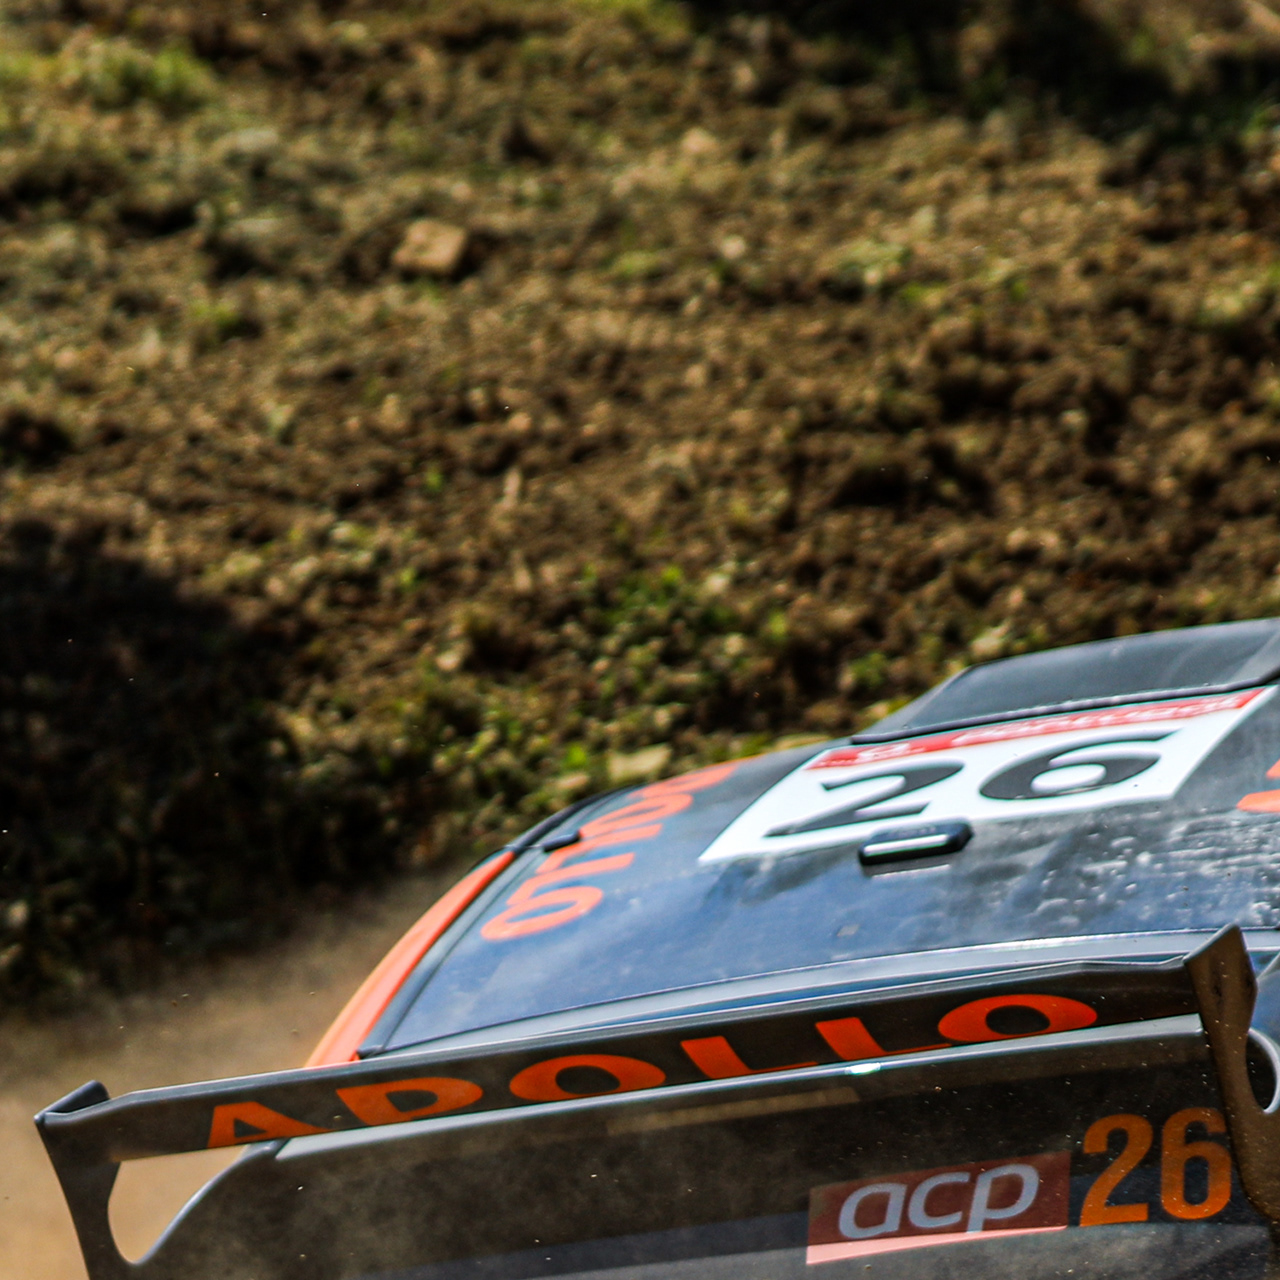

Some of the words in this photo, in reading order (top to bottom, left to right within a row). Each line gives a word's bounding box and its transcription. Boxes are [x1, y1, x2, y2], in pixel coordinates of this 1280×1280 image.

[762, 729, 1184, 838] 26
[207, 993, 1098, 1149] APOLLO
[838, 1163, 1040, 1239] acp
[1080, 1107, 1233, 1228] 26
